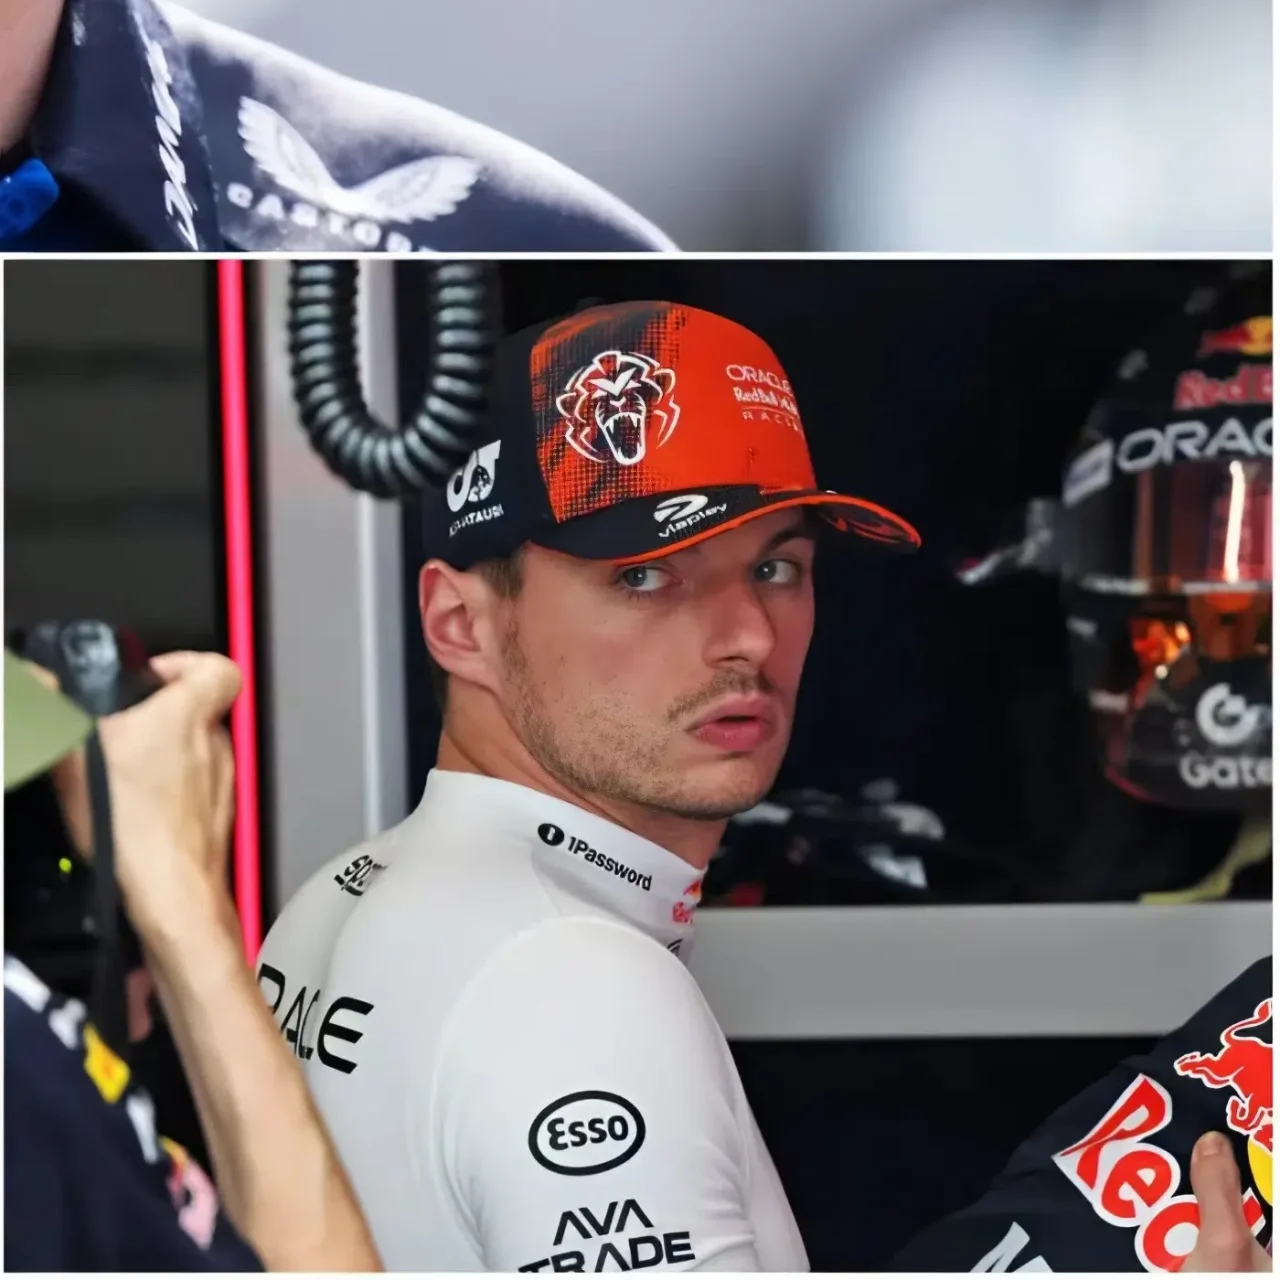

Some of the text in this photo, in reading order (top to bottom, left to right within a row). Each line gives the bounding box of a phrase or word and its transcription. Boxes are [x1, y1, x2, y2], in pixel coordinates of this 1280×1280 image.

[567, 836, 653, 891] 1Password
[546, 1114, 630, 1151] Esso
[552, 1198, 655, 1246] AVA
